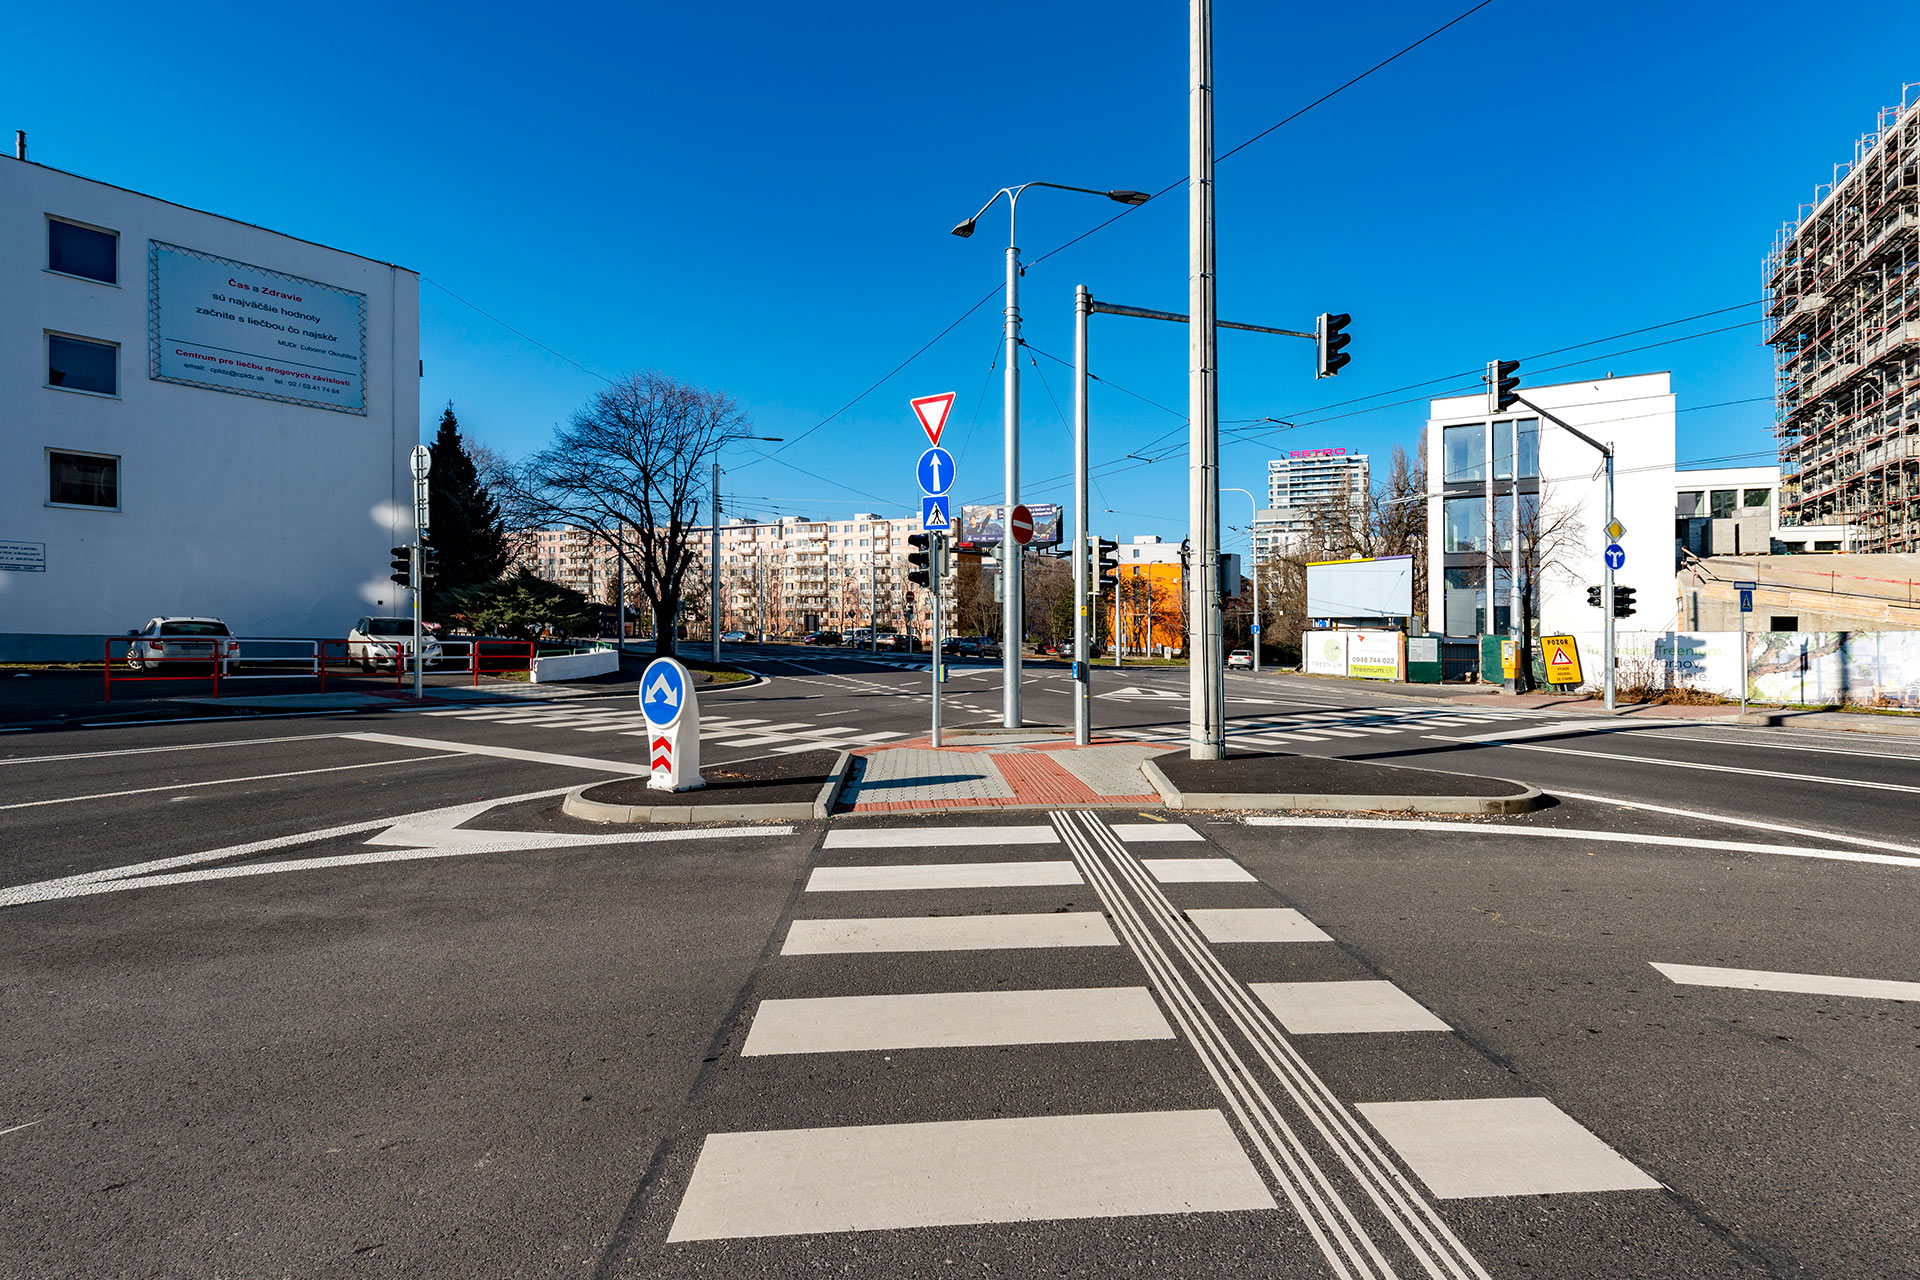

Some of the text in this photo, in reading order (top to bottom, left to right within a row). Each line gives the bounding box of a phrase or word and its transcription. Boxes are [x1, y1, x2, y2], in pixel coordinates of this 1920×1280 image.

[228, 278, 303, 303] Čas a Zdravie
[212, 293, 321, 325] sú najväčšie hodnoty
[196, 306, 236, 321] začnite
[247, 317, 285, 331] liečbou
[287, 324, 300, 335] čo
[302, 329, 338, 343] najskôr
[175, 348, 217, 362] Centrum
[218, 357, 234, 365] pre
[236, 359, 264, 371] liečbu
[265, 365, 311, 379] drogových
[1289, 447, 1347, 458] RETRO
[1547, 638, 1569, 646] POZOR
[1585, 644, 1599, 656] Tu
[1312, 660, 1342, 668] TREENUM
[1351, 656, 1369, 664] 0948
[1382, 657, 1395, 665] 022
